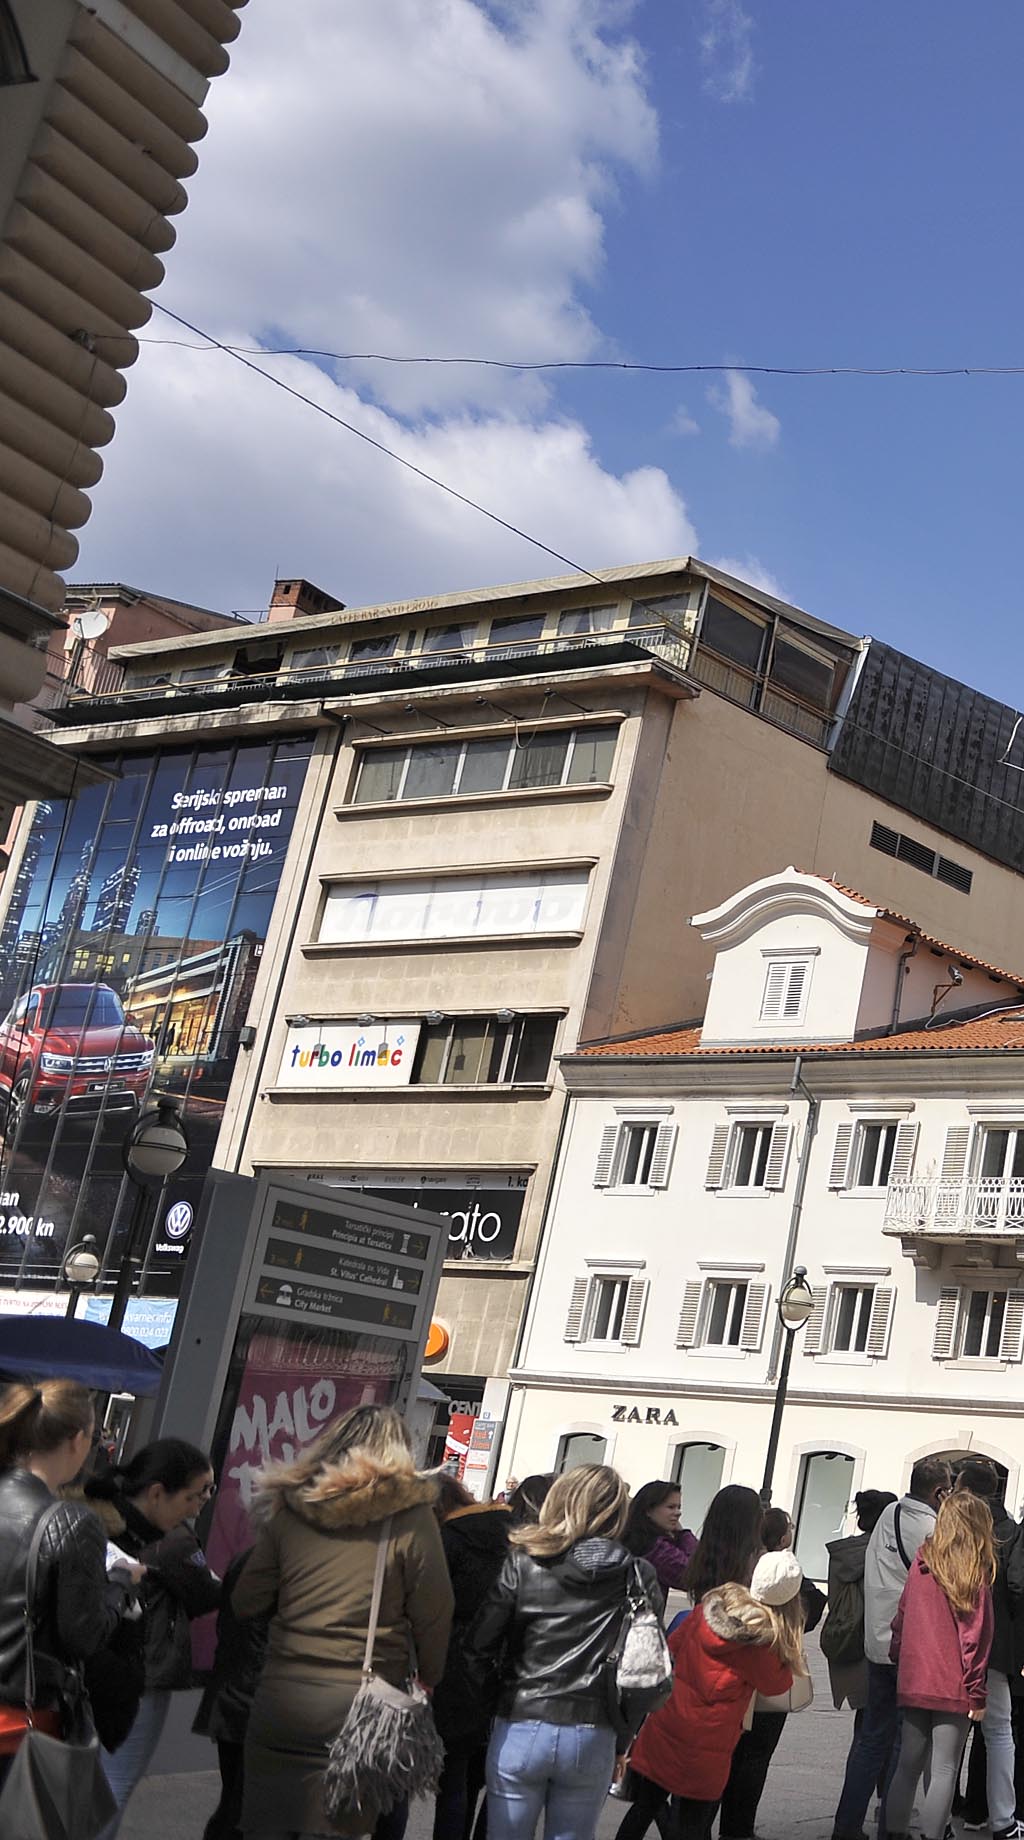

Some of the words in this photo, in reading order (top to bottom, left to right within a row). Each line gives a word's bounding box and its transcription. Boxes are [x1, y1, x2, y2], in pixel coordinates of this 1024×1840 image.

[171, 788, 223, 811] Serijski
[223, 786, 287, 807] spreman
[151, 824, 168, 838] za
[169, 814, 226, 835] offroad,
[228, 809, 282, 831] onroad
[168, 845, 176, 862] i
[176, 843, 221, 861] online
[222, 839, 273, 860] vožnju.
[291, 1044, 342, 1067] turbo
[35, 1217, 55, 1237] kn
[359, 1273, 388, 1287] Cathedral
[294, 1299, 308, 1311] City
[309, 1301, 332, 1313] Market
[230, 1378, 336, 1464] MALO
[611, 1404, 679, 1426] ZARA
